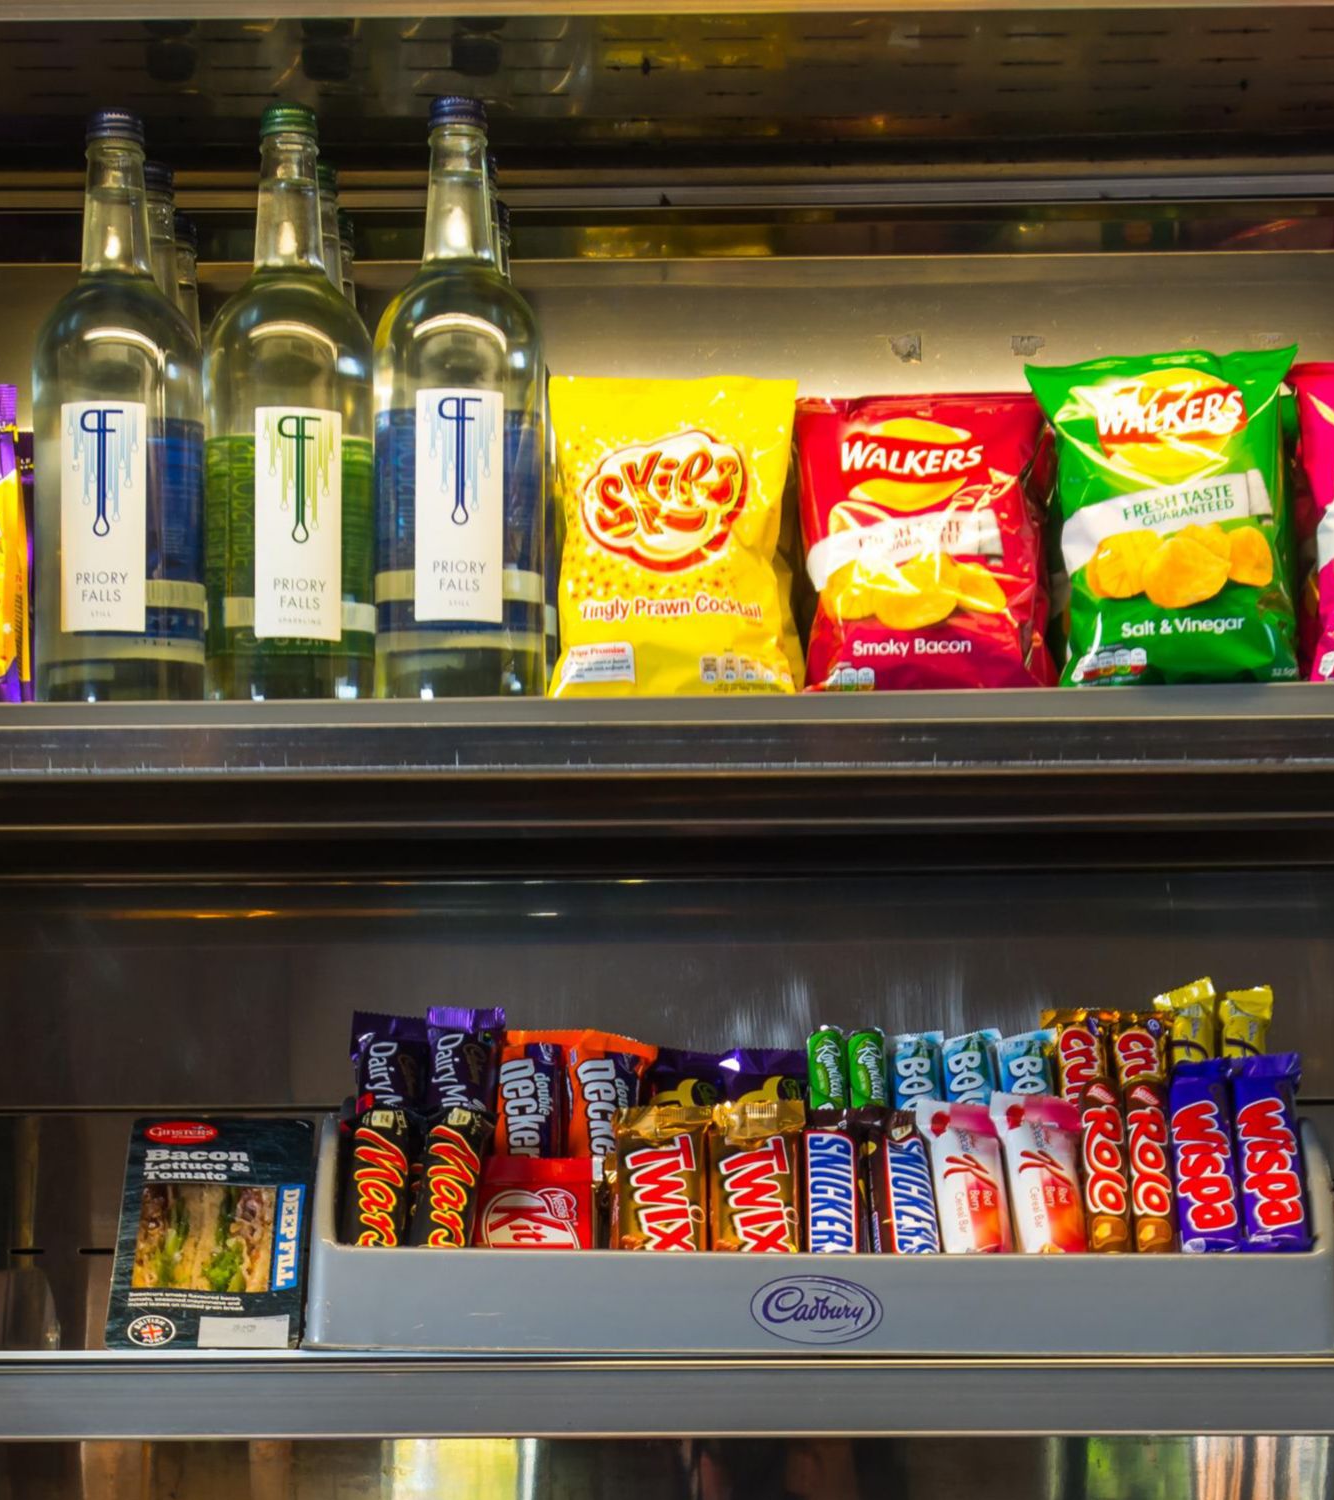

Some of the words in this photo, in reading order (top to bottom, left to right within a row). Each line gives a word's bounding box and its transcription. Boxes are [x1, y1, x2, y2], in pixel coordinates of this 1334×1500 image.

[840, 442, 985, 477] WALKERS
[1122, 488, 1181, 523] FRESH
[1181, 484, 1234, 509] TASTE
[1141, 497, 1235, 526] GUARANTEED
[75, 571, 129, 586] PRIORY
[432, 560, 487, 576] PRIORY
[81, 588, 123, 604] FALLS
[273, 577, 328, 593] PRIORY
[438, 577, 480, 594] FALLS
[279, 597, 321, 611] FALLS
[634, 597, 692, 618] Prawn
[1120, 619, 1156, 638] Salt
[1158, 619, 1173, 635] &
[1173, 615, 1245, 636] Vinegar
[852, 639, 910, 660] Smoky
[913, 637, 972, 655] Bacon
[366, 1040, 399, 1094] Dairy
[431, 1032, 465, 1092] Dairy
[533, 1072, 552, 1117] double
[143, 1161, 229, 1172] Lettuce
[230, 1162, 251, 1173] &
[145, 1149, 250, 1162] Bacon
[1082, 1104, 1128, 1215] Rolo
[1127, 1106, 1172, 1217] Rolo
[1170, 1100, 1238, 1234] Wispa
[1237, 1097, 1304, 1230] Wispa
[143, 1170, 228, 1181] Tomato
[626, 1133, 705, 1251] Twix
[719, 1135, 799, 1251] Twix
[954, 1191, 966, 1218] Cereal
[969, 1188, 980, 1212] Berry
[981, 1189, 994, 1207] Red
[1056, 1186, 1069, 1205] Red
[279, 1187, 301, 1240] DEEP
[275, 1240, 298, 1288] FILL
[761, 1285, 865, 1325] Cadbury
